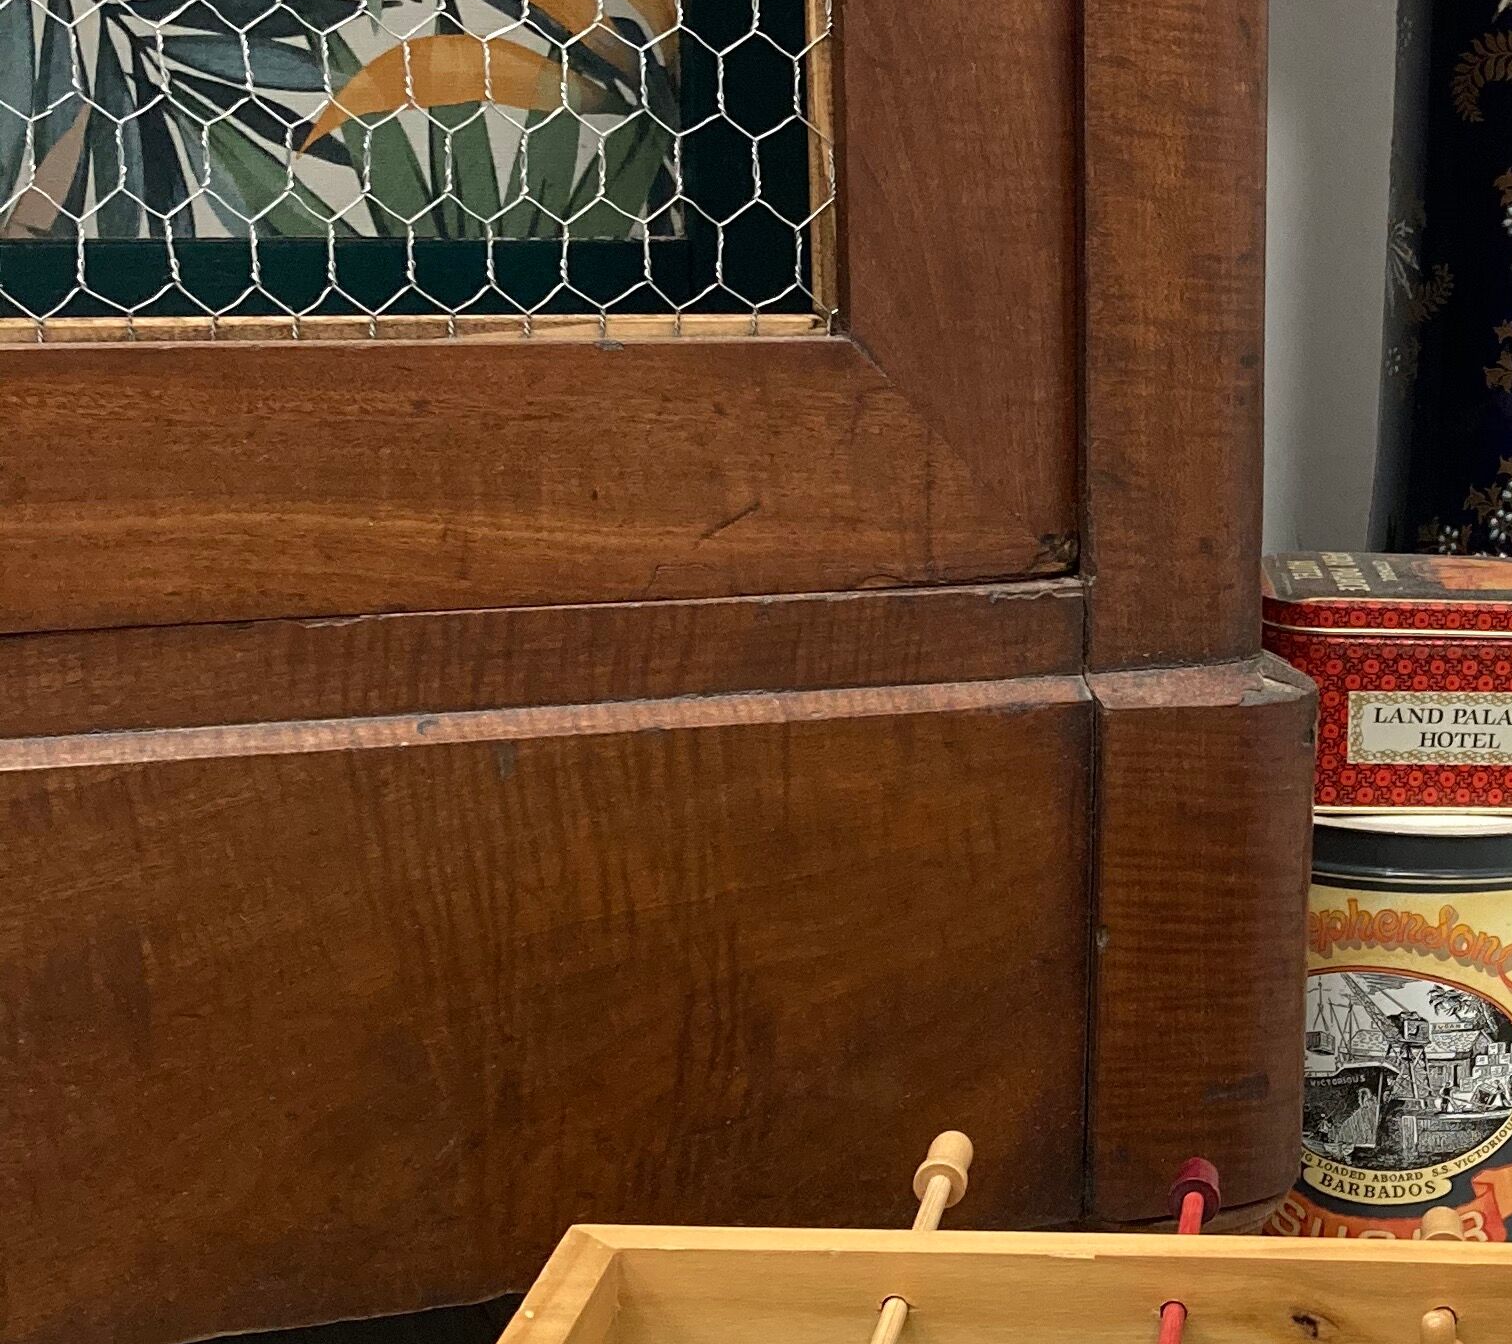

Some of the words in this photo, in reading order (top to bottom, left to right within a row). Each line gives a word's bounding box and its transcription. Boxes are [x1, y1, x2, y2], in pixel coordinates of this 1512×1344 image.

[1373, 706, 1445, 726] LAND
[1419, 731, 1501, 750] HOTEL
[1316, 1158, 1367, 1181] LOADED
[1371, 1171, 1424, 1183] ABOARD
[1319, 1172, 1437, 1199] BARBADOS
